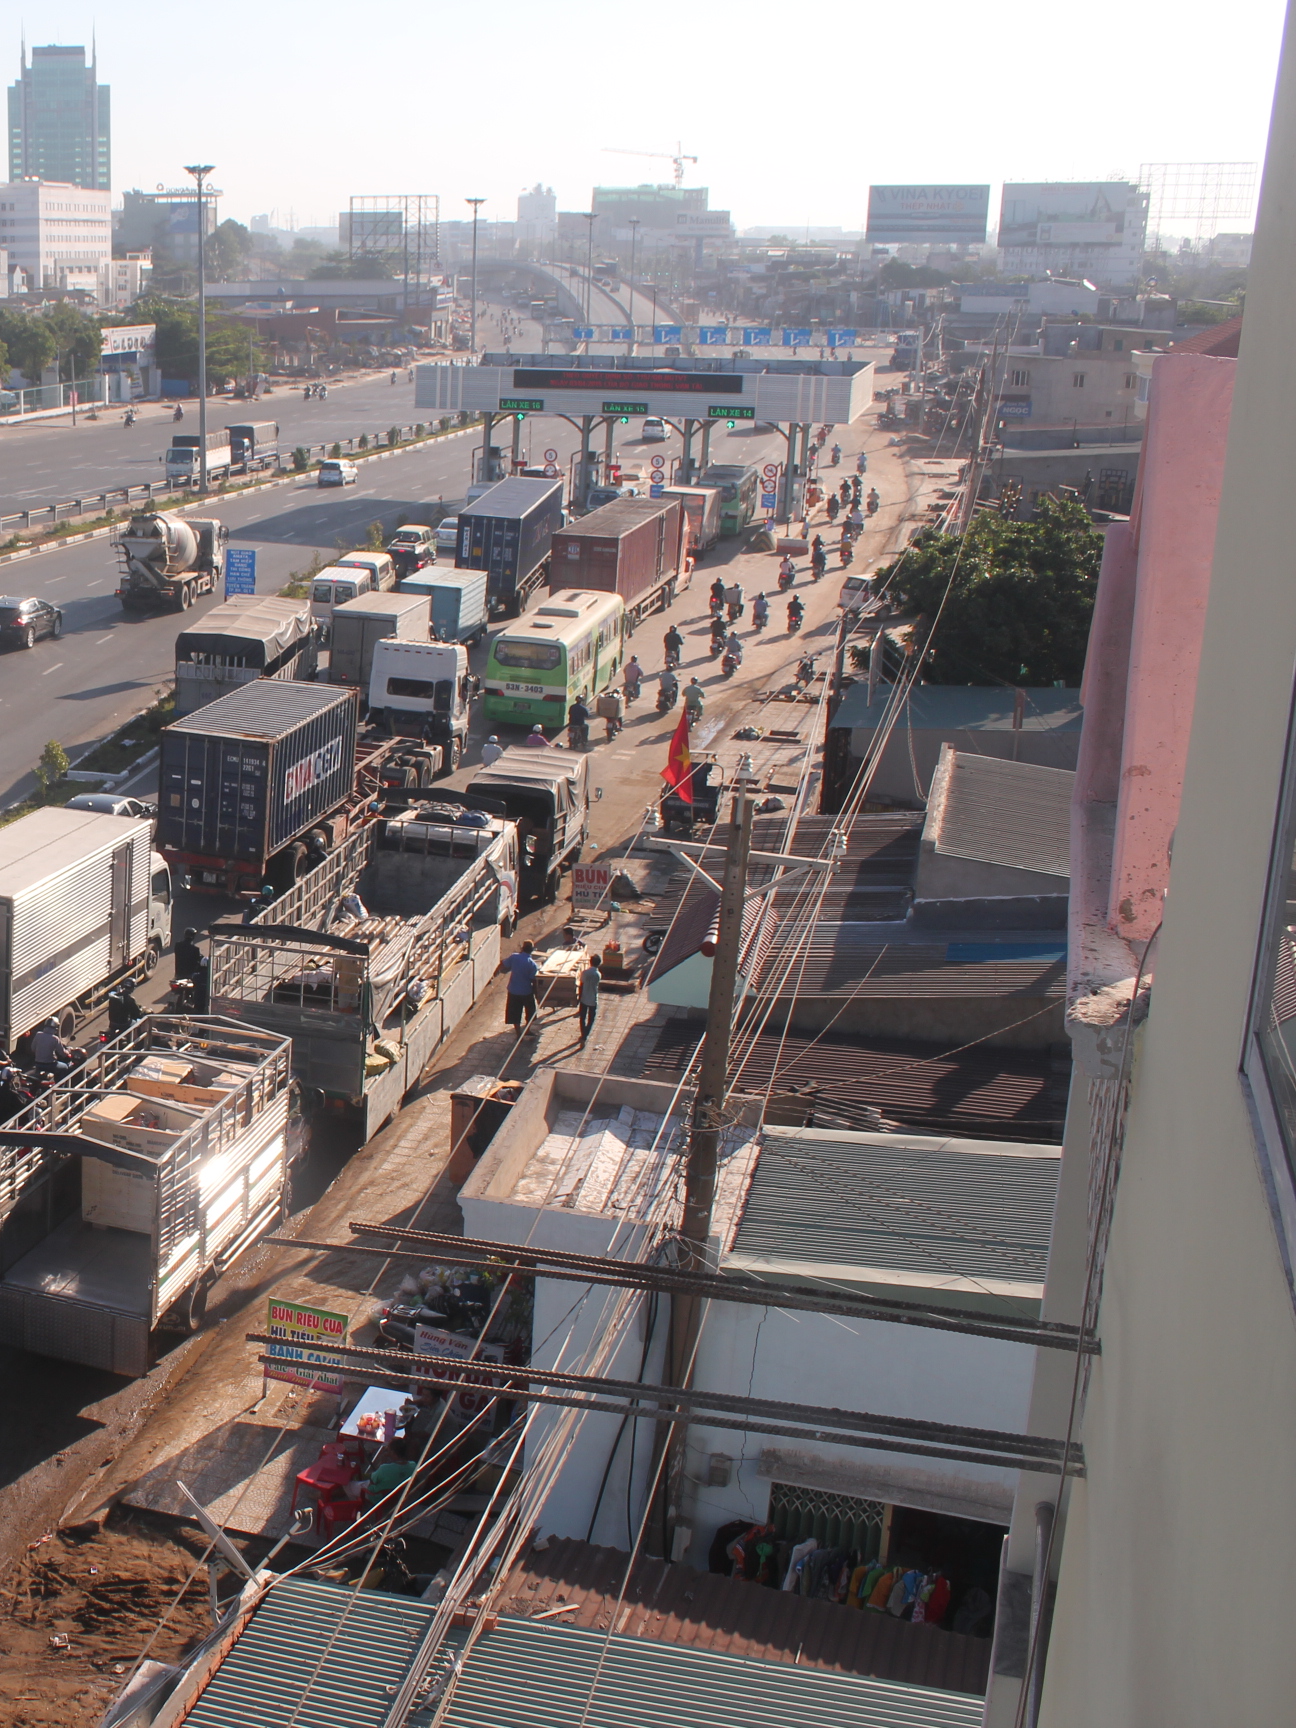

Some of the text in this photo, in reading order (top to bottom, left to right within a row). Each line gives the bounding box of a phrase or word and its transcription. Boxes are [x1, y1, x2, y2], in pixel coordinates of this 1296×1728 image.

[890, 187, 983, 200] VINA KYOEI
[519, 400, 530, 409] XE
[531, 401, 541, 409] 16
[636, 405, 645, 413] 15
[729, 409, 741, 417] XE
[742, 410, 752, 418] 14
[227, 755, 239, 763] ECMU
[285, 757, 313, 801] CMA
[575, 866, 608, 885] BÚN
[271, 1304, 343, 1335] BÚN RIÊU CUA
[419, 1331, 446, 1346] Hùng
[459, 1392, 491, 1416] GA
